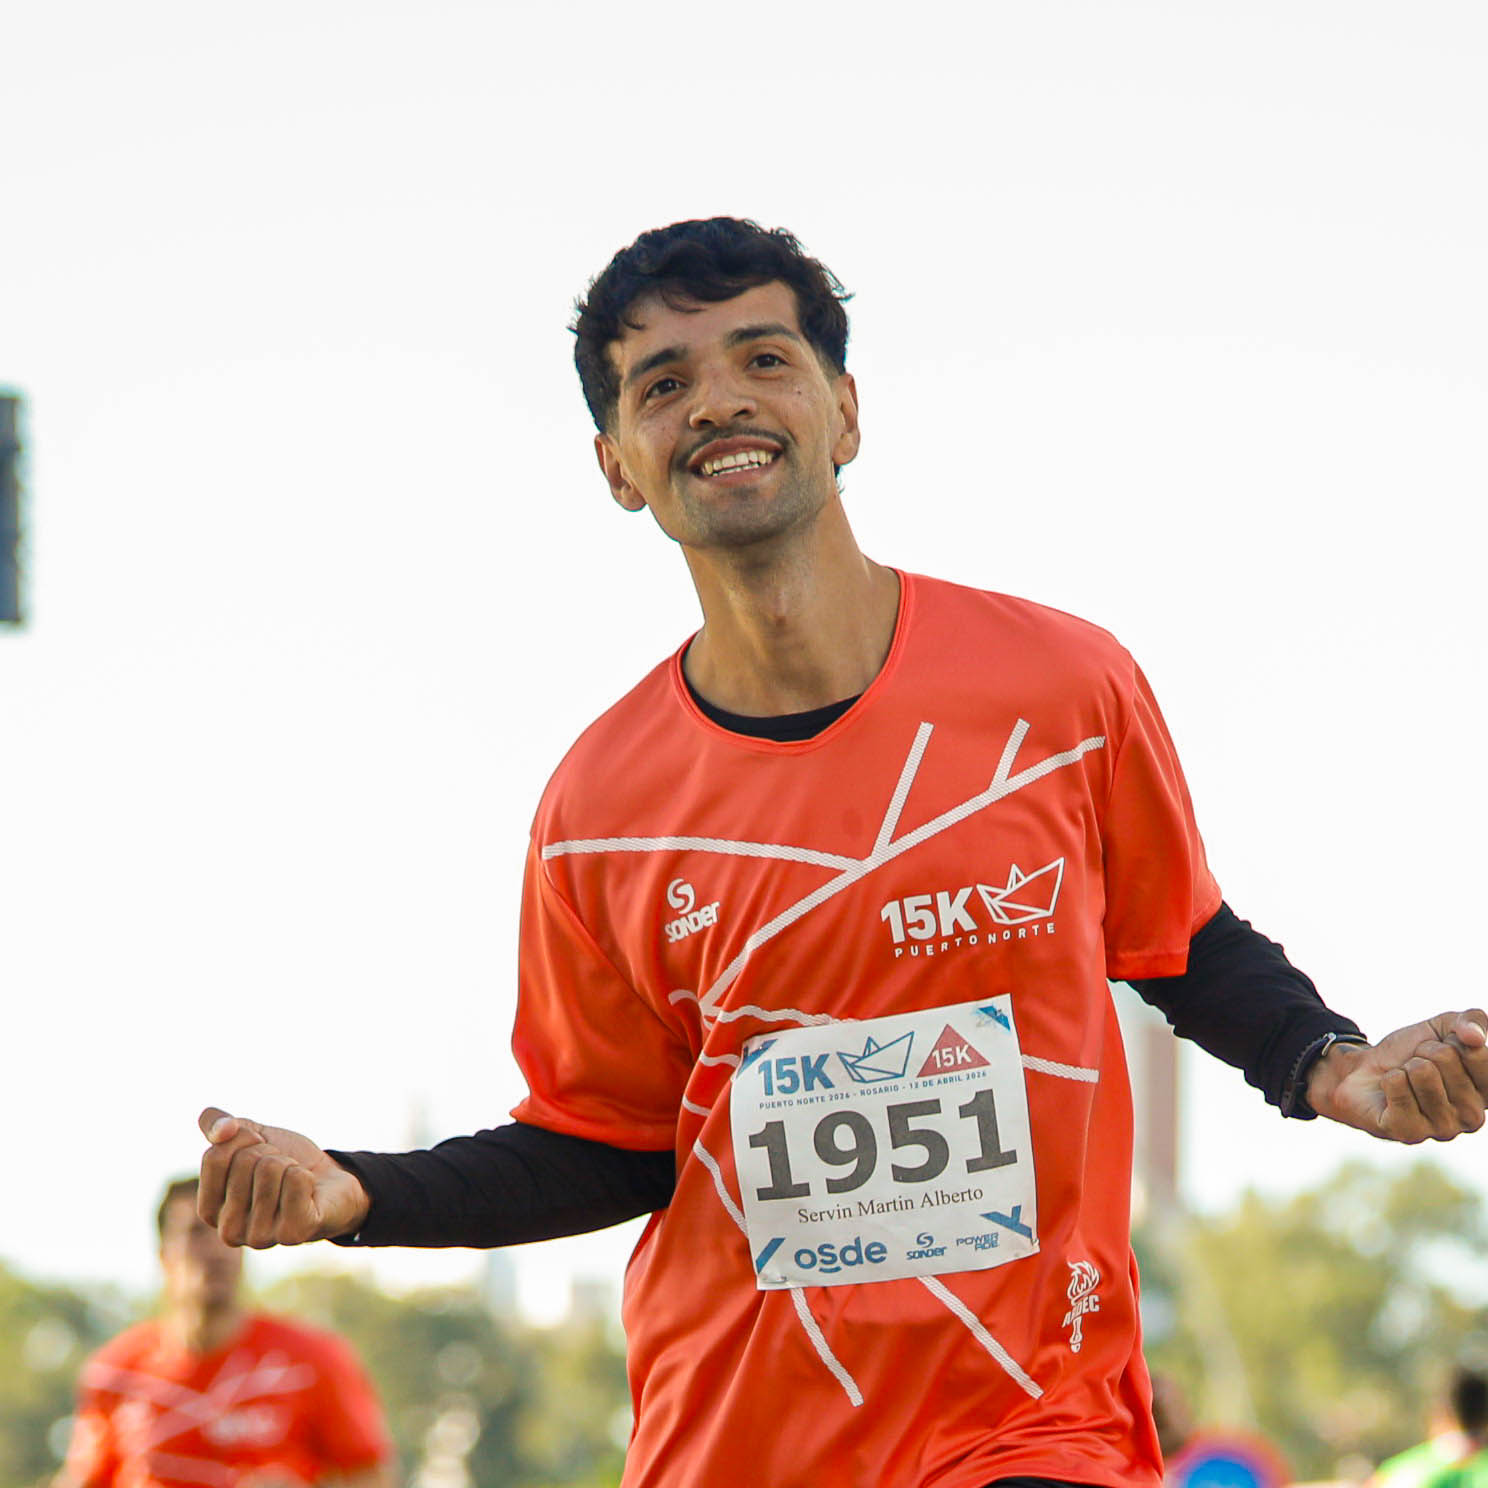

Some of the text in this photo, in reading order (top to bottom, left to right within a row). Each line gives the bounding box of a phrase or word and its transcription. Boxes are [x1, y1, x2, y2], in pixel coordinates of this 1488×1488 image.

[880, 886, 978, 944] 15K
[894, 922, 1055, 958] PUERTO NORTE
[757, 1053, 835, 1097] 15K
[932, 1044, 973, 1068] 15K
[759, 1100, 794, 1110] PUERTO
[796, 1095, 826, 1106] NORTE
[829, 1091, 851, 1102] 2026
[860, 1084, 899, 1097] ROSARIO
[922, 1079, 934, 1088] DE
[937, 1075, 963, 1086] ABRIL
[966, 1071, 988, 1082] 2026
[748, 1088, 1018, 1202] 1951
[798, 1186, 984, 1224] Servin Martin Alberto
[794, 1236, 888, 1273] osde
